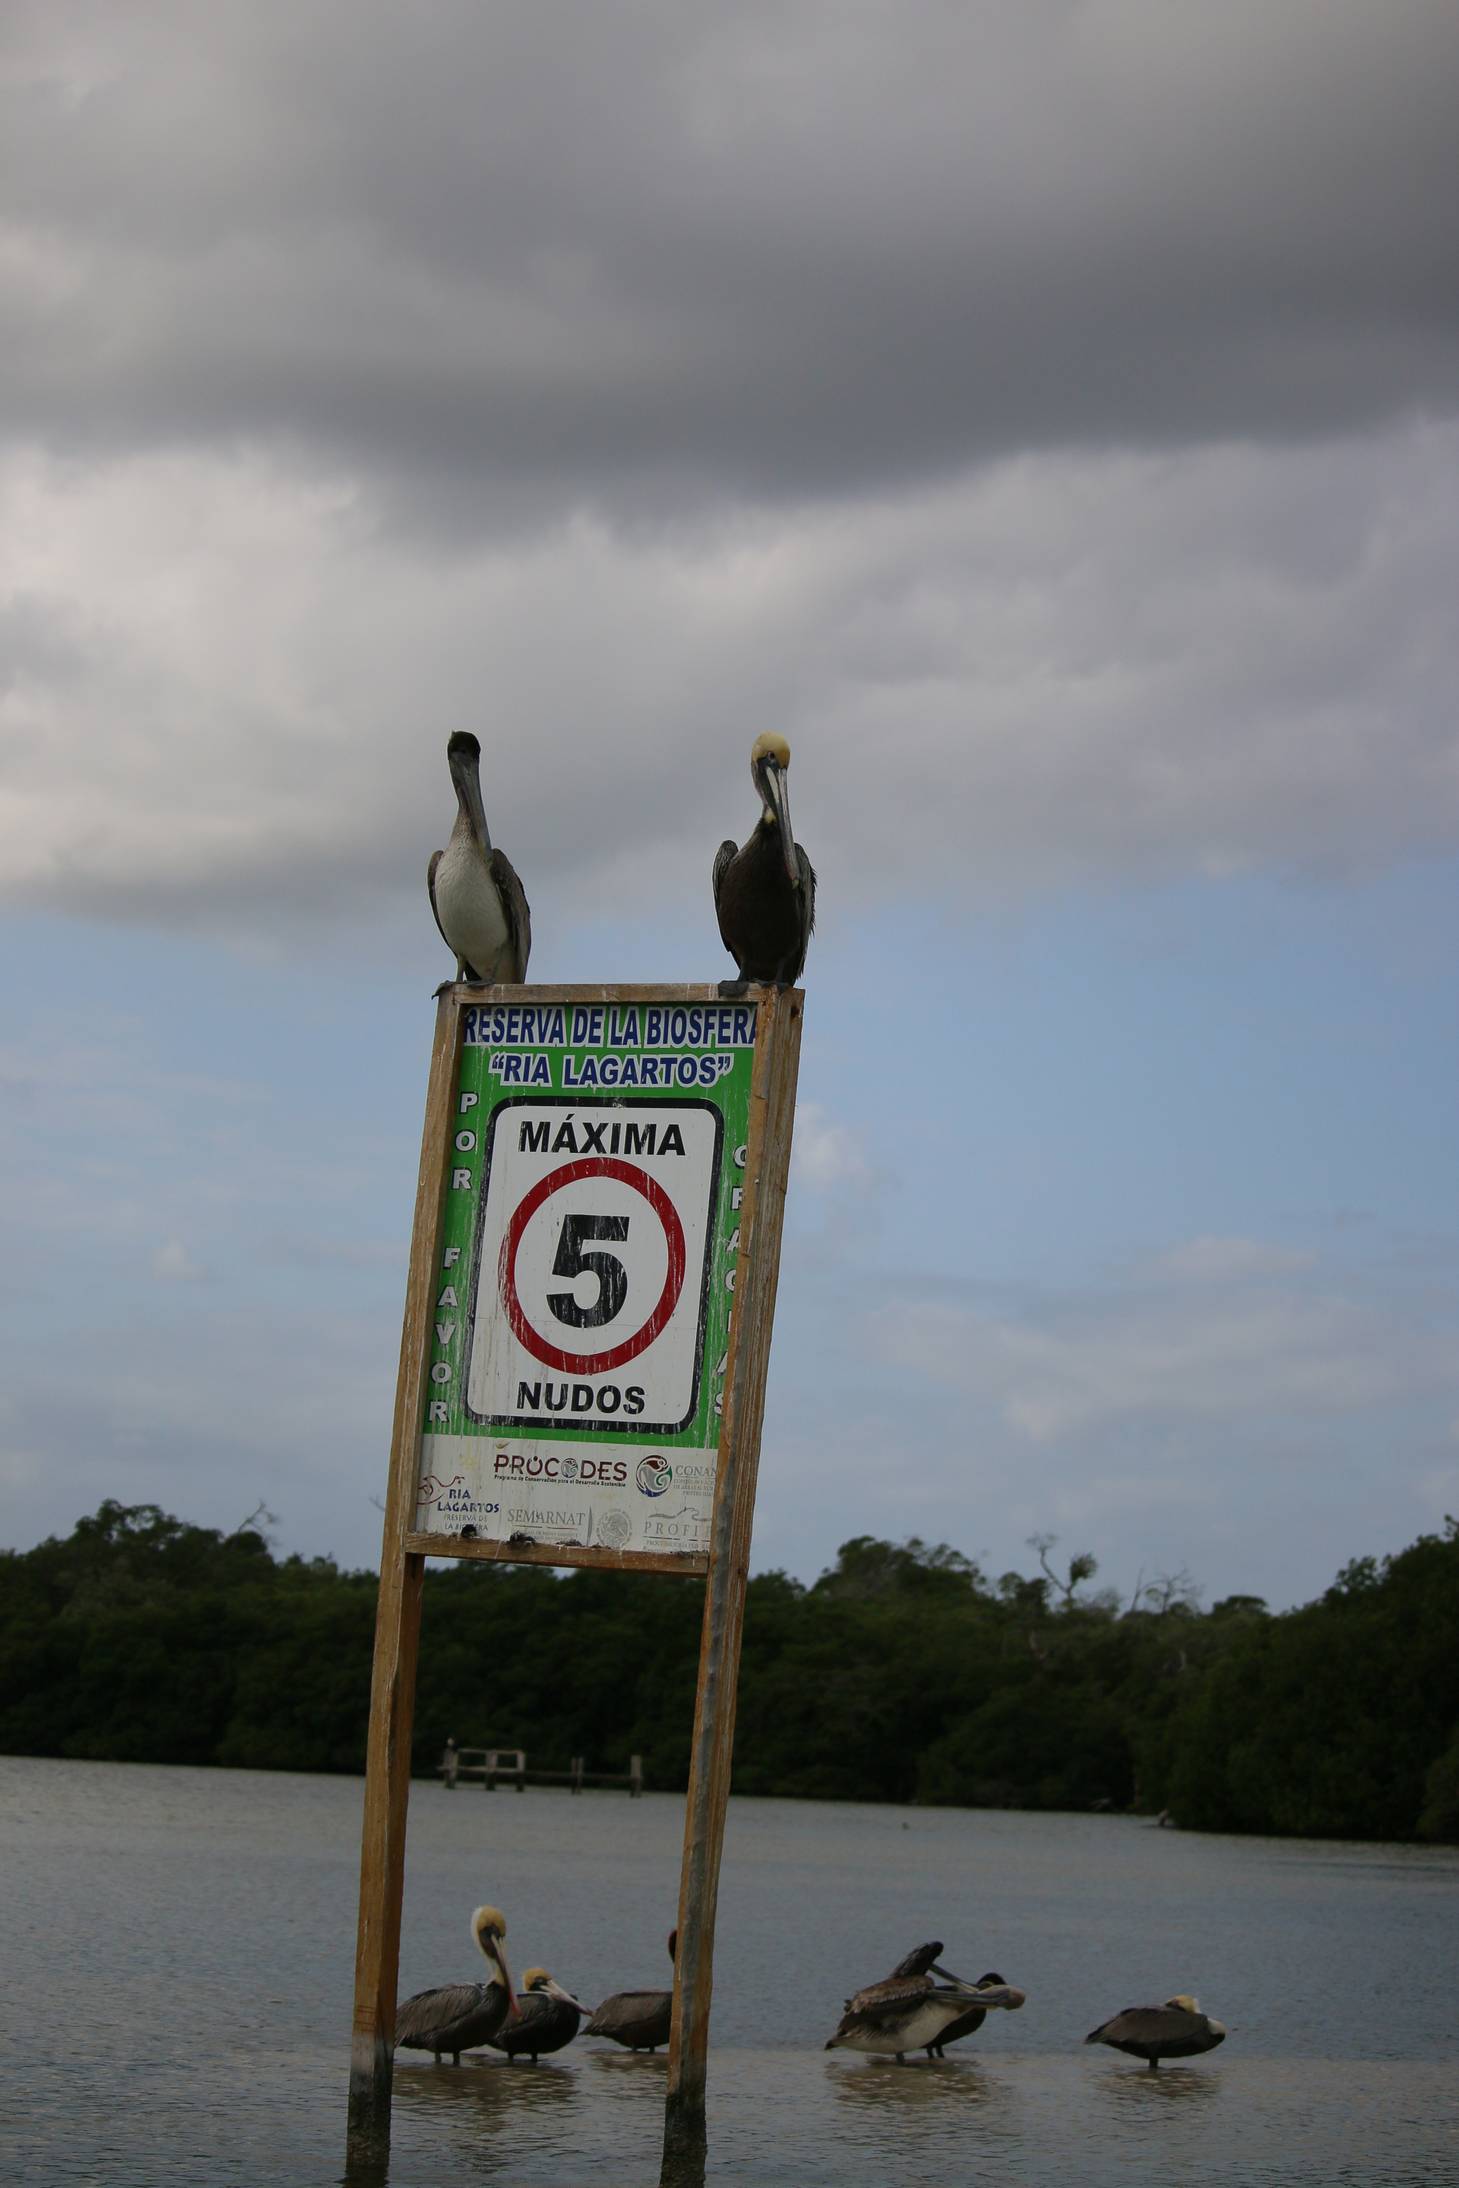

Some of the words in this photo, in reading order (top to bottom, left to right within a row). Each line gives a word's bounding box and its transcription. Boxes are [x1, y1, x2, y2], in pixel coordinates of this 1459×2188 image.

[464, 1007, 563, 1044] RESERVA
[571, 1008, 604, 1044] DE
[610, 1008, 639, 1045] LA
[452, 1092, 479, 1190] POR
[519, 1113, 686, 1156] MÁXIMA
[546, 1214, 630, 1329] 5
[429, 1247, 461, 1423] FAVOR
[516, 1381, 645, 1416] NUDOS
[494, 1454, 628, 1482] PROCODES
[437, 1501, 500, 1513] LAGARTOS
[449, 1488, 471, 1499] RIA
[507, 1508, 586, 1526] SEMARNAT
